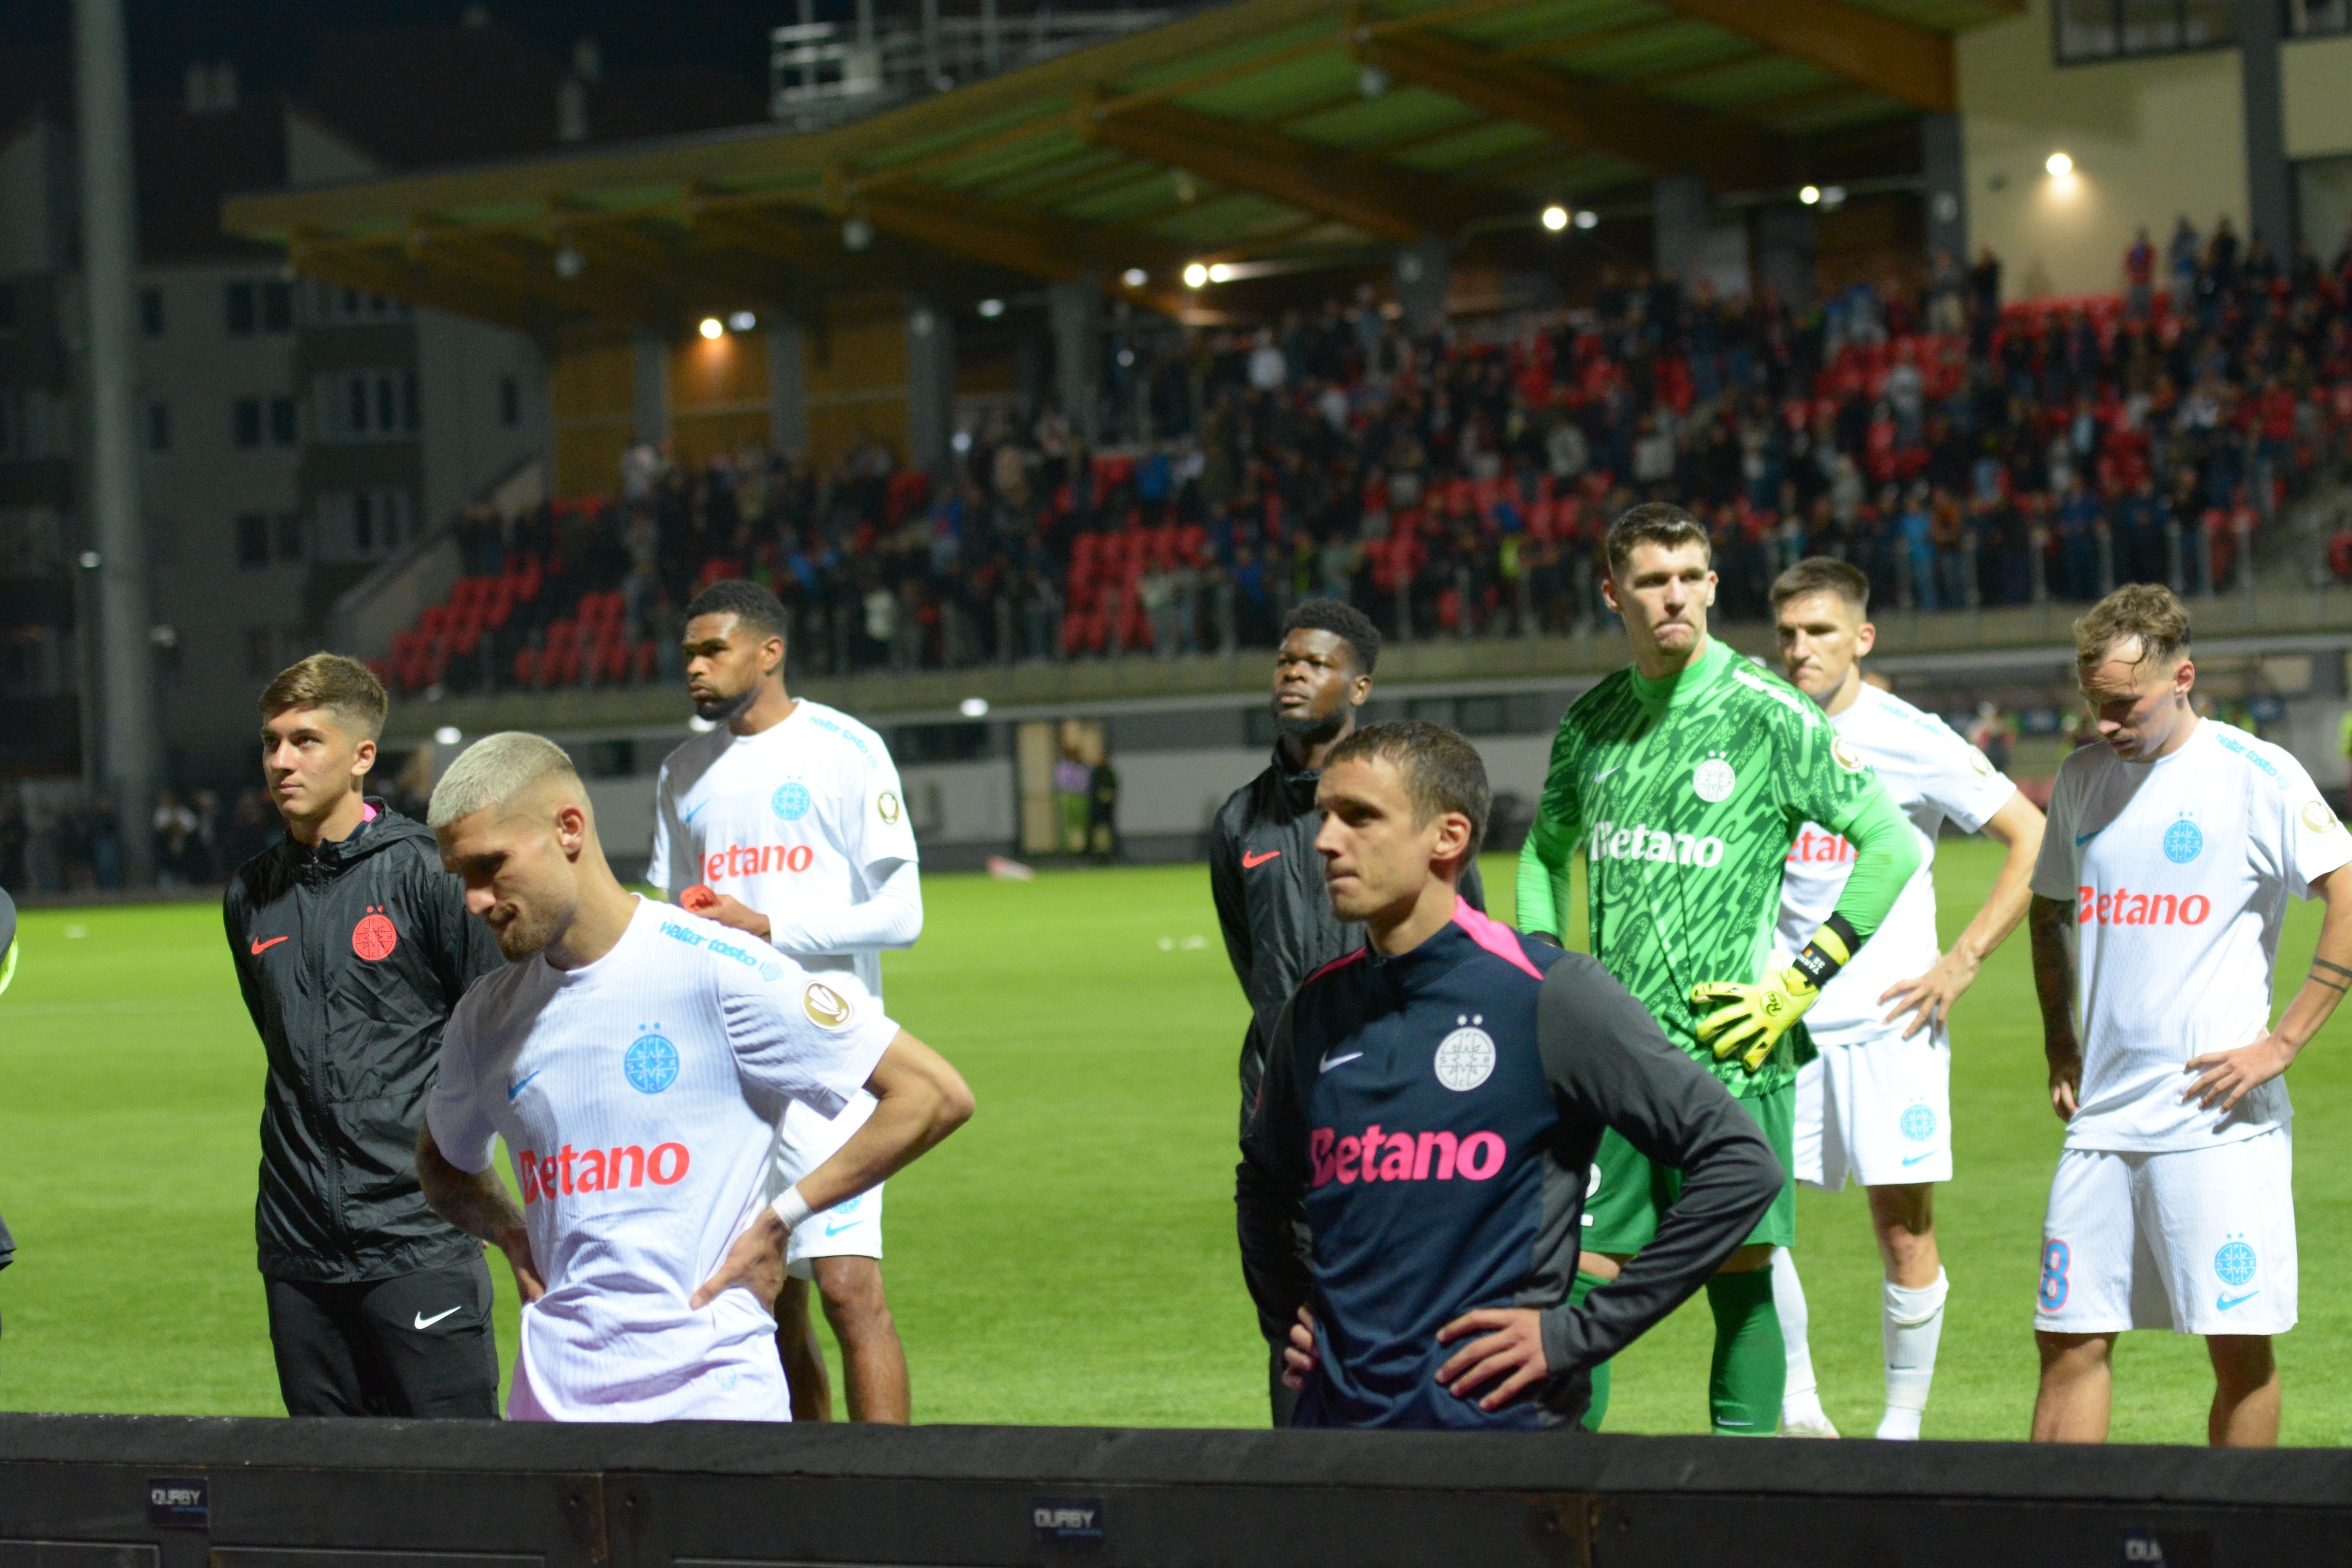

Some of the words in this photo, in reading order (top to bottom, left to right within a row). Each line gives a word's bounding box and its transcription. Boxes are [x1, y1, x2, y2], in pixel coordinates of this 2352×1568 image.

[1590, 821, 1724, 868] Betano
[659, 921, 708, 946] walter
[708, 939, 757, 966] tosto
[519, 1142, 690, 1205] Betano
[1311, 1124, 1506, 1188] Betano
[2039, 1239, 2071, 1312] 8
